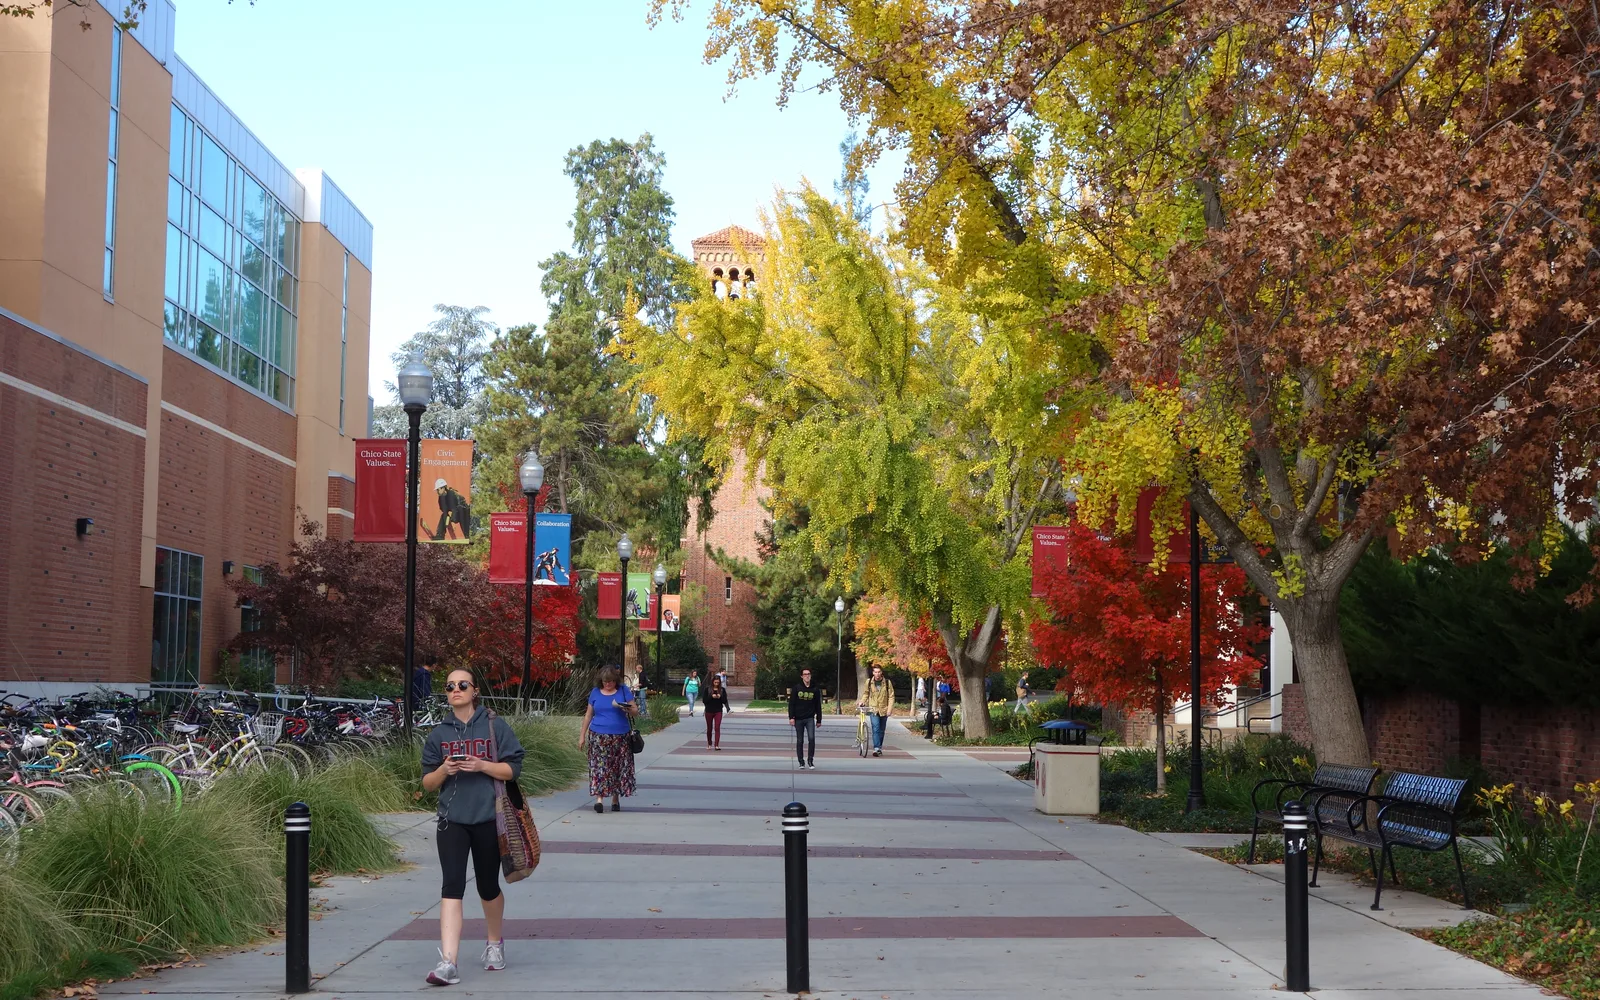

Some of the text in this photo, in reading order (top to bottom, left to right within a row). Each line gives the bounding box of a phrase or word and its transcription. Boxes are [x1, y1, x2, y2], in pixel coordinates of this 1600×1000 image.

[360, 450, 402, 458] Chico State
[437, 449, 455, 457] Civic
[365, 459, 396, 467] Values...
[423, 458, 468, 467] Engagement
